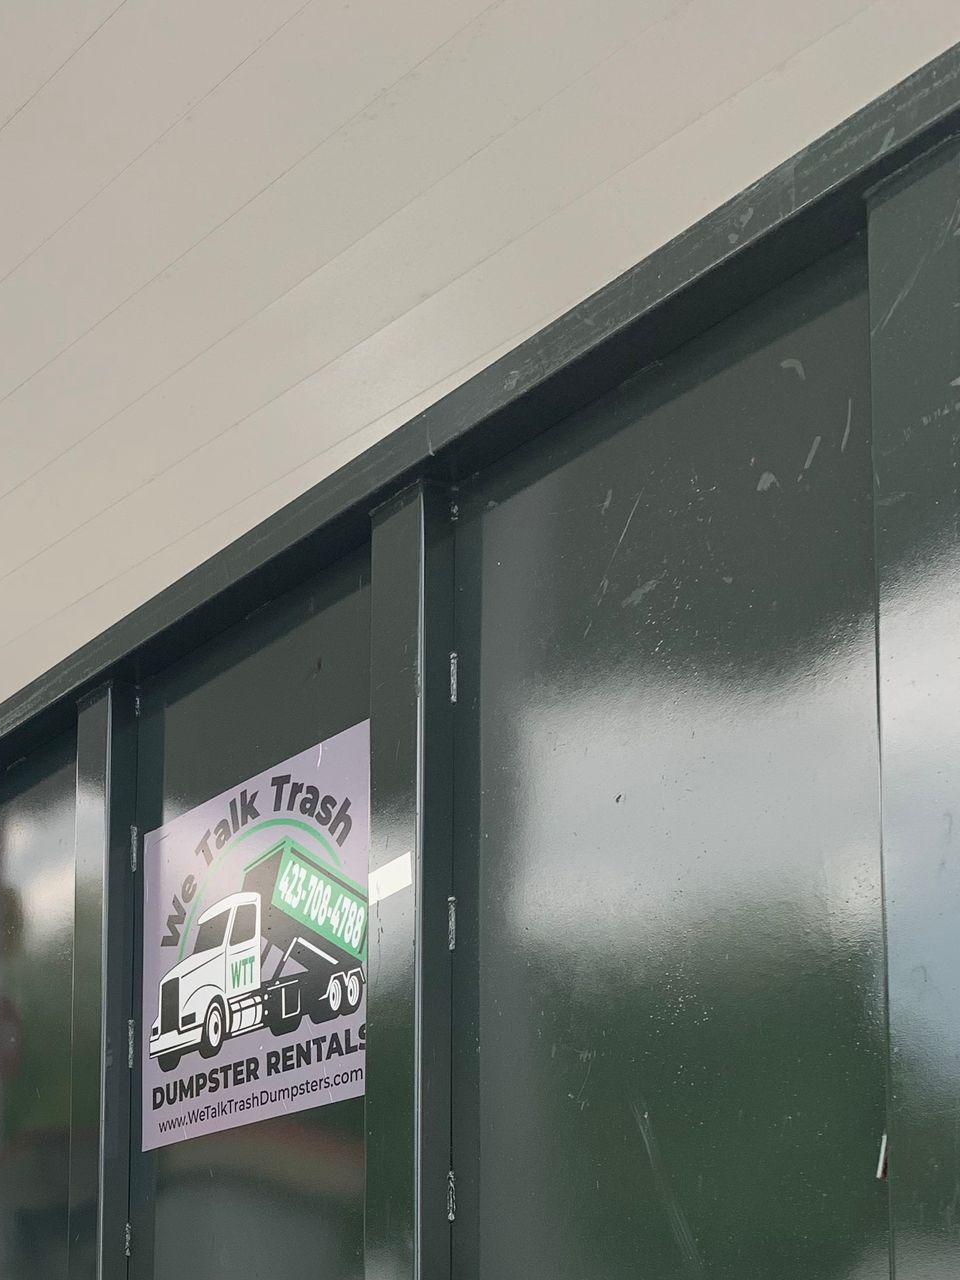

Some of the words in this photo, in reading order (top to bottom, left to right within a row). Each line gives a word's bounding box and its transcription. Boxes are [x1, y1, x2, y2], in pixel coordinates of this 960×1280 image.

[160, 879, 197, 948] We
[195, 787, 260, 869] Talk
[271, 774, 353, 848] Trash
[278, 860, 364, 949] 423-708-4788
[230, 955, 255, 989] WTT
[152, 1056, 260, 1111] DUMPSTER
[266, 1023, 366, 1077] RENTALS
[158, 1067, 363, 1133] www.WeTalkTrashDumpsters.com
